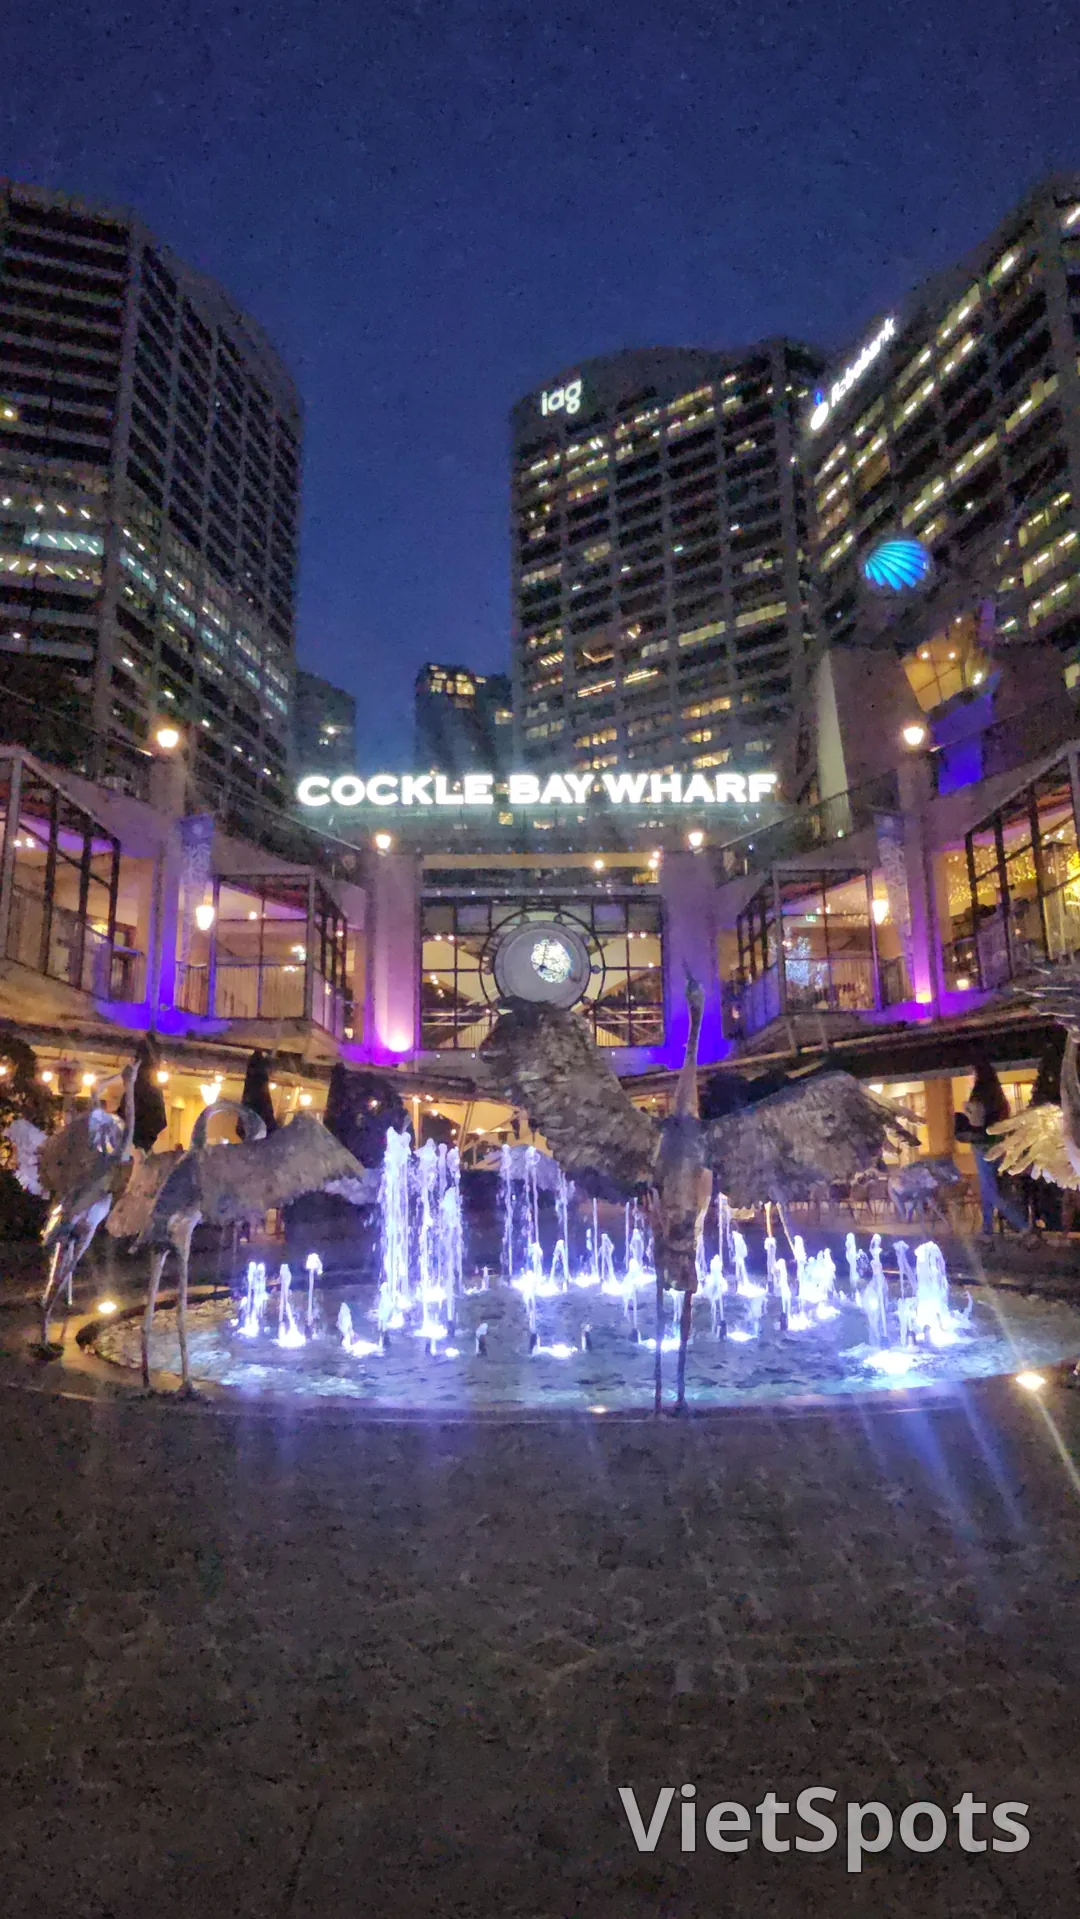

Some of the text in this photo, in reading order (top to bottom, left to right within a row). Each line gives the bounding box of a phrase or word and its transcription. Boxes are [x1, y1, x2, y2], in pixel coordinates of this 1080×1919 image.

[297, 774, 778, 806] COCKLE BAY WHARF
